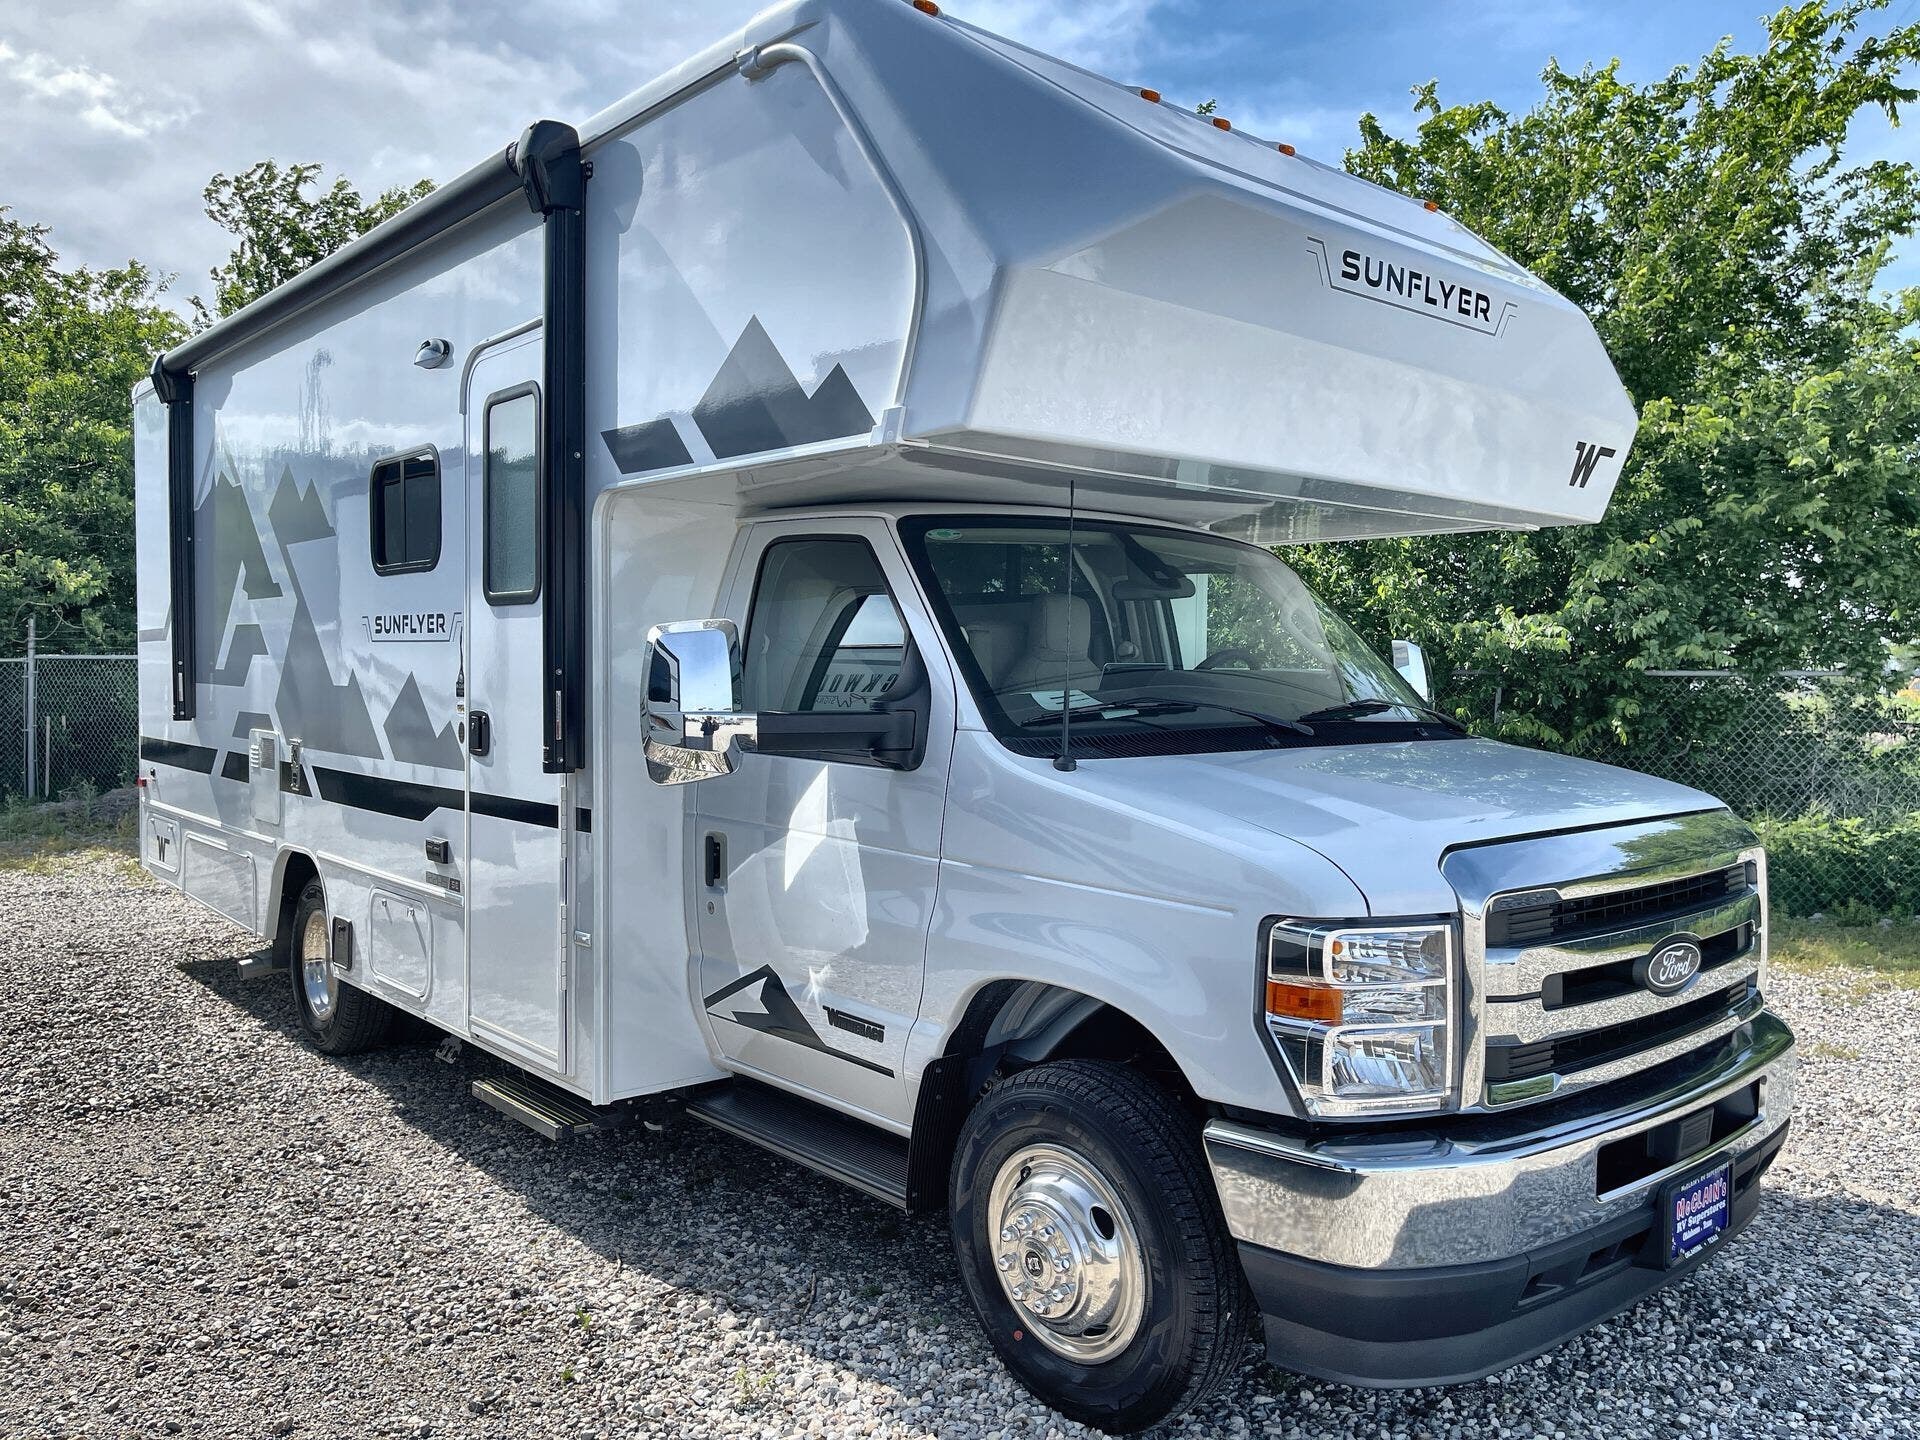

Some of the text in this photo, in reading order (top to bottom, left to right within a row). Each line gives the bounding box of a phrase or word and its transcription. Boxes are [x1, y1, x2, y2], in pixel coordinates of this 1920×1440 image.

[1341, 250, 1491, 323] SUNFLYER
[374, 613, 446, 634] SUNFLYER
[1660, 949, 1692, 981] Ford
[1676, 1218, 1687, 1233] RV
